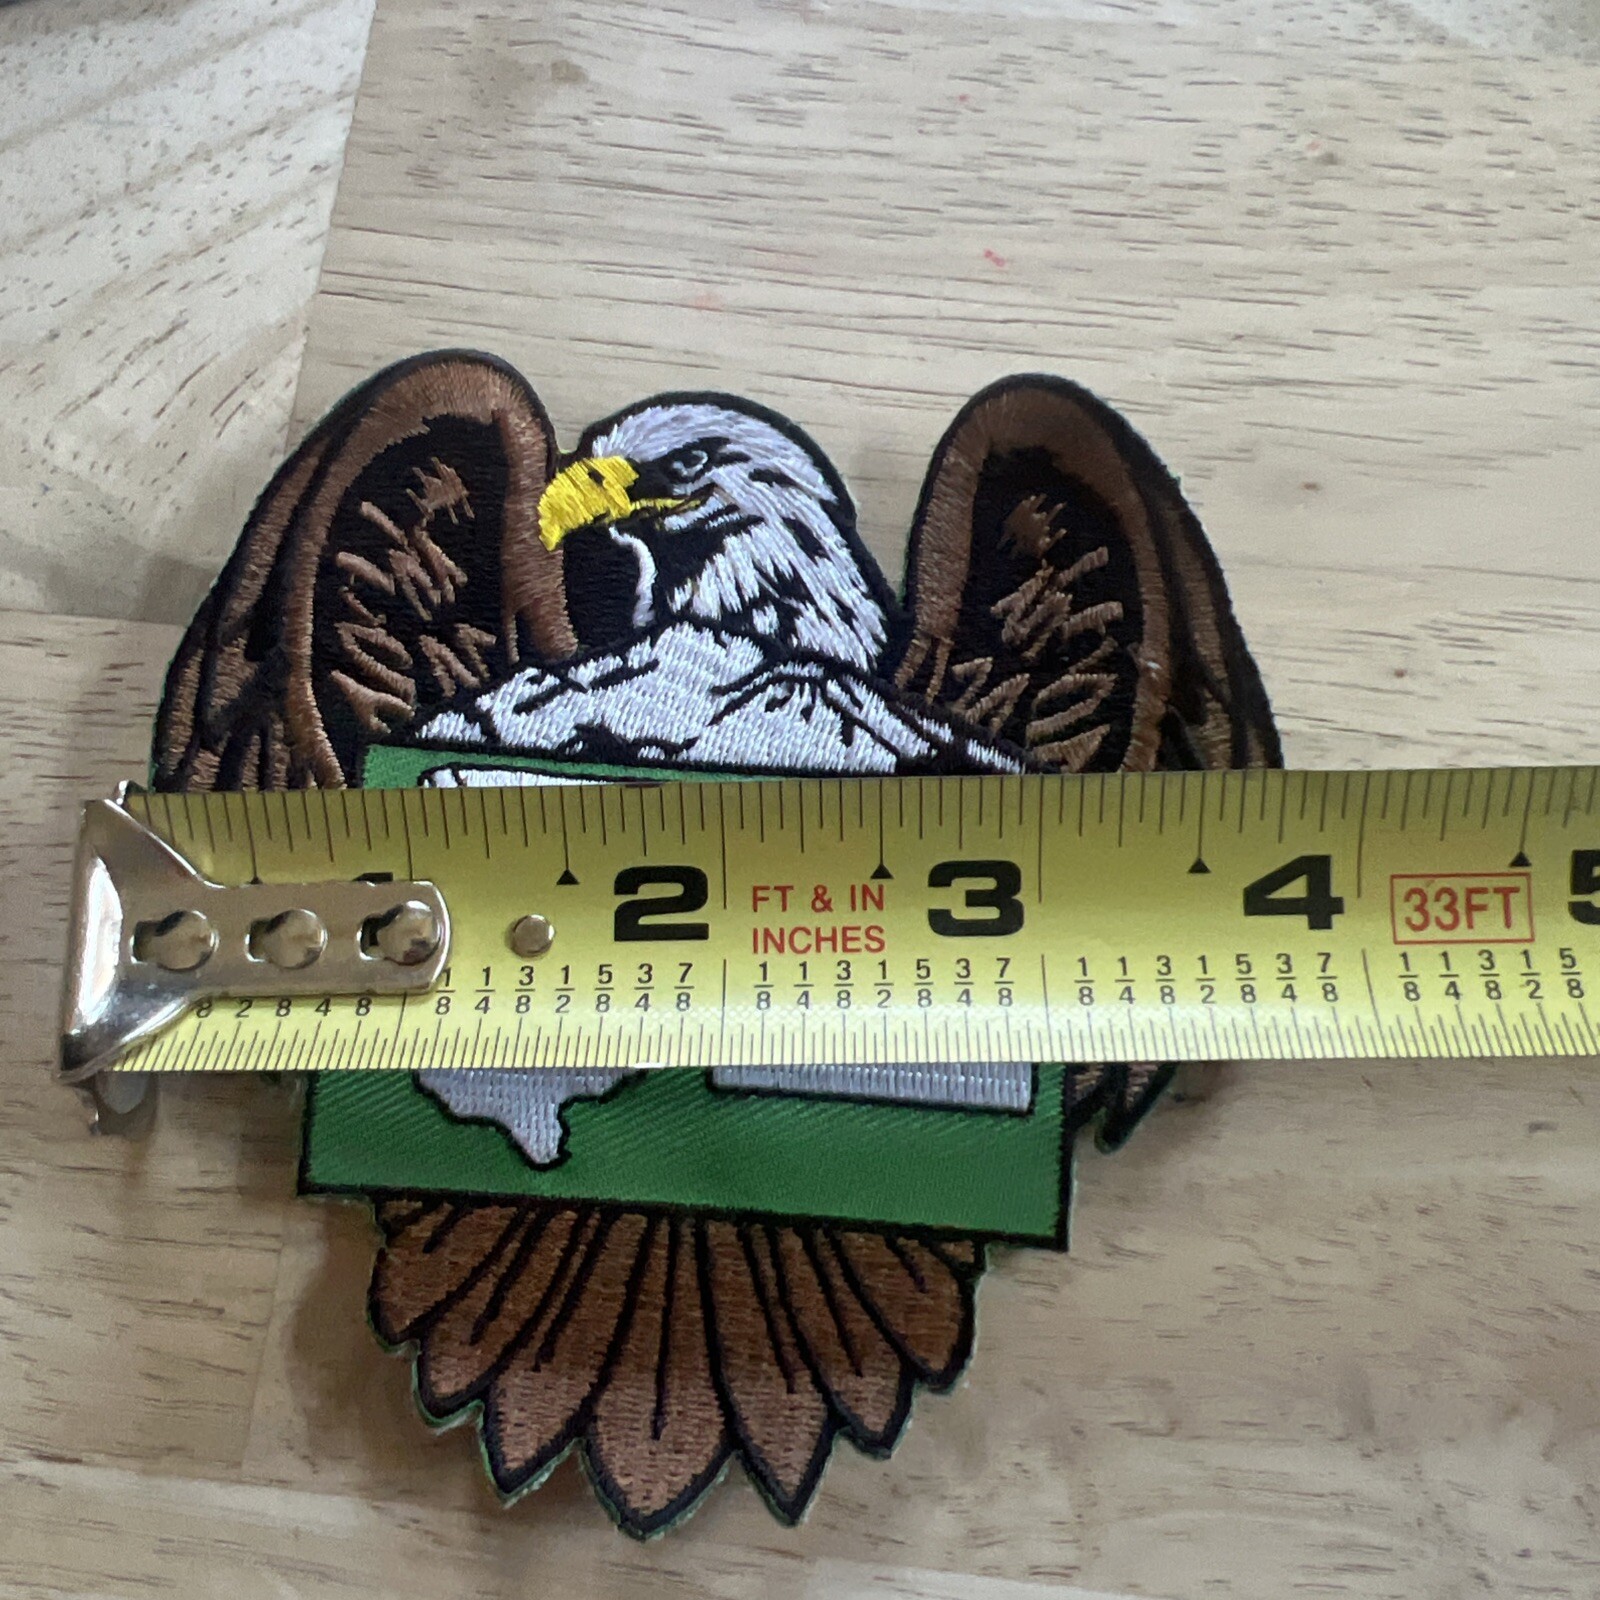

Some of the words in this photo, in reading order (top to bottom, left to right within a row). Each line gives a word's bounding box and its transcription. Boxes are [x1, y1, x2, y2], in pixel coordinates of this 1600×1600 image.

[614, 865, 709, 942] 2
[752, 885, 794, 912] FT
[811, 884, 833, 912] &
[850, 884, 884, 911] IN
[928, 860, 1024, 937] 3
[1243, 855, 1344, 930] 4
[1404, 887, 1520, 932] 33FT
[752, 925, 885, 954] INCHES
